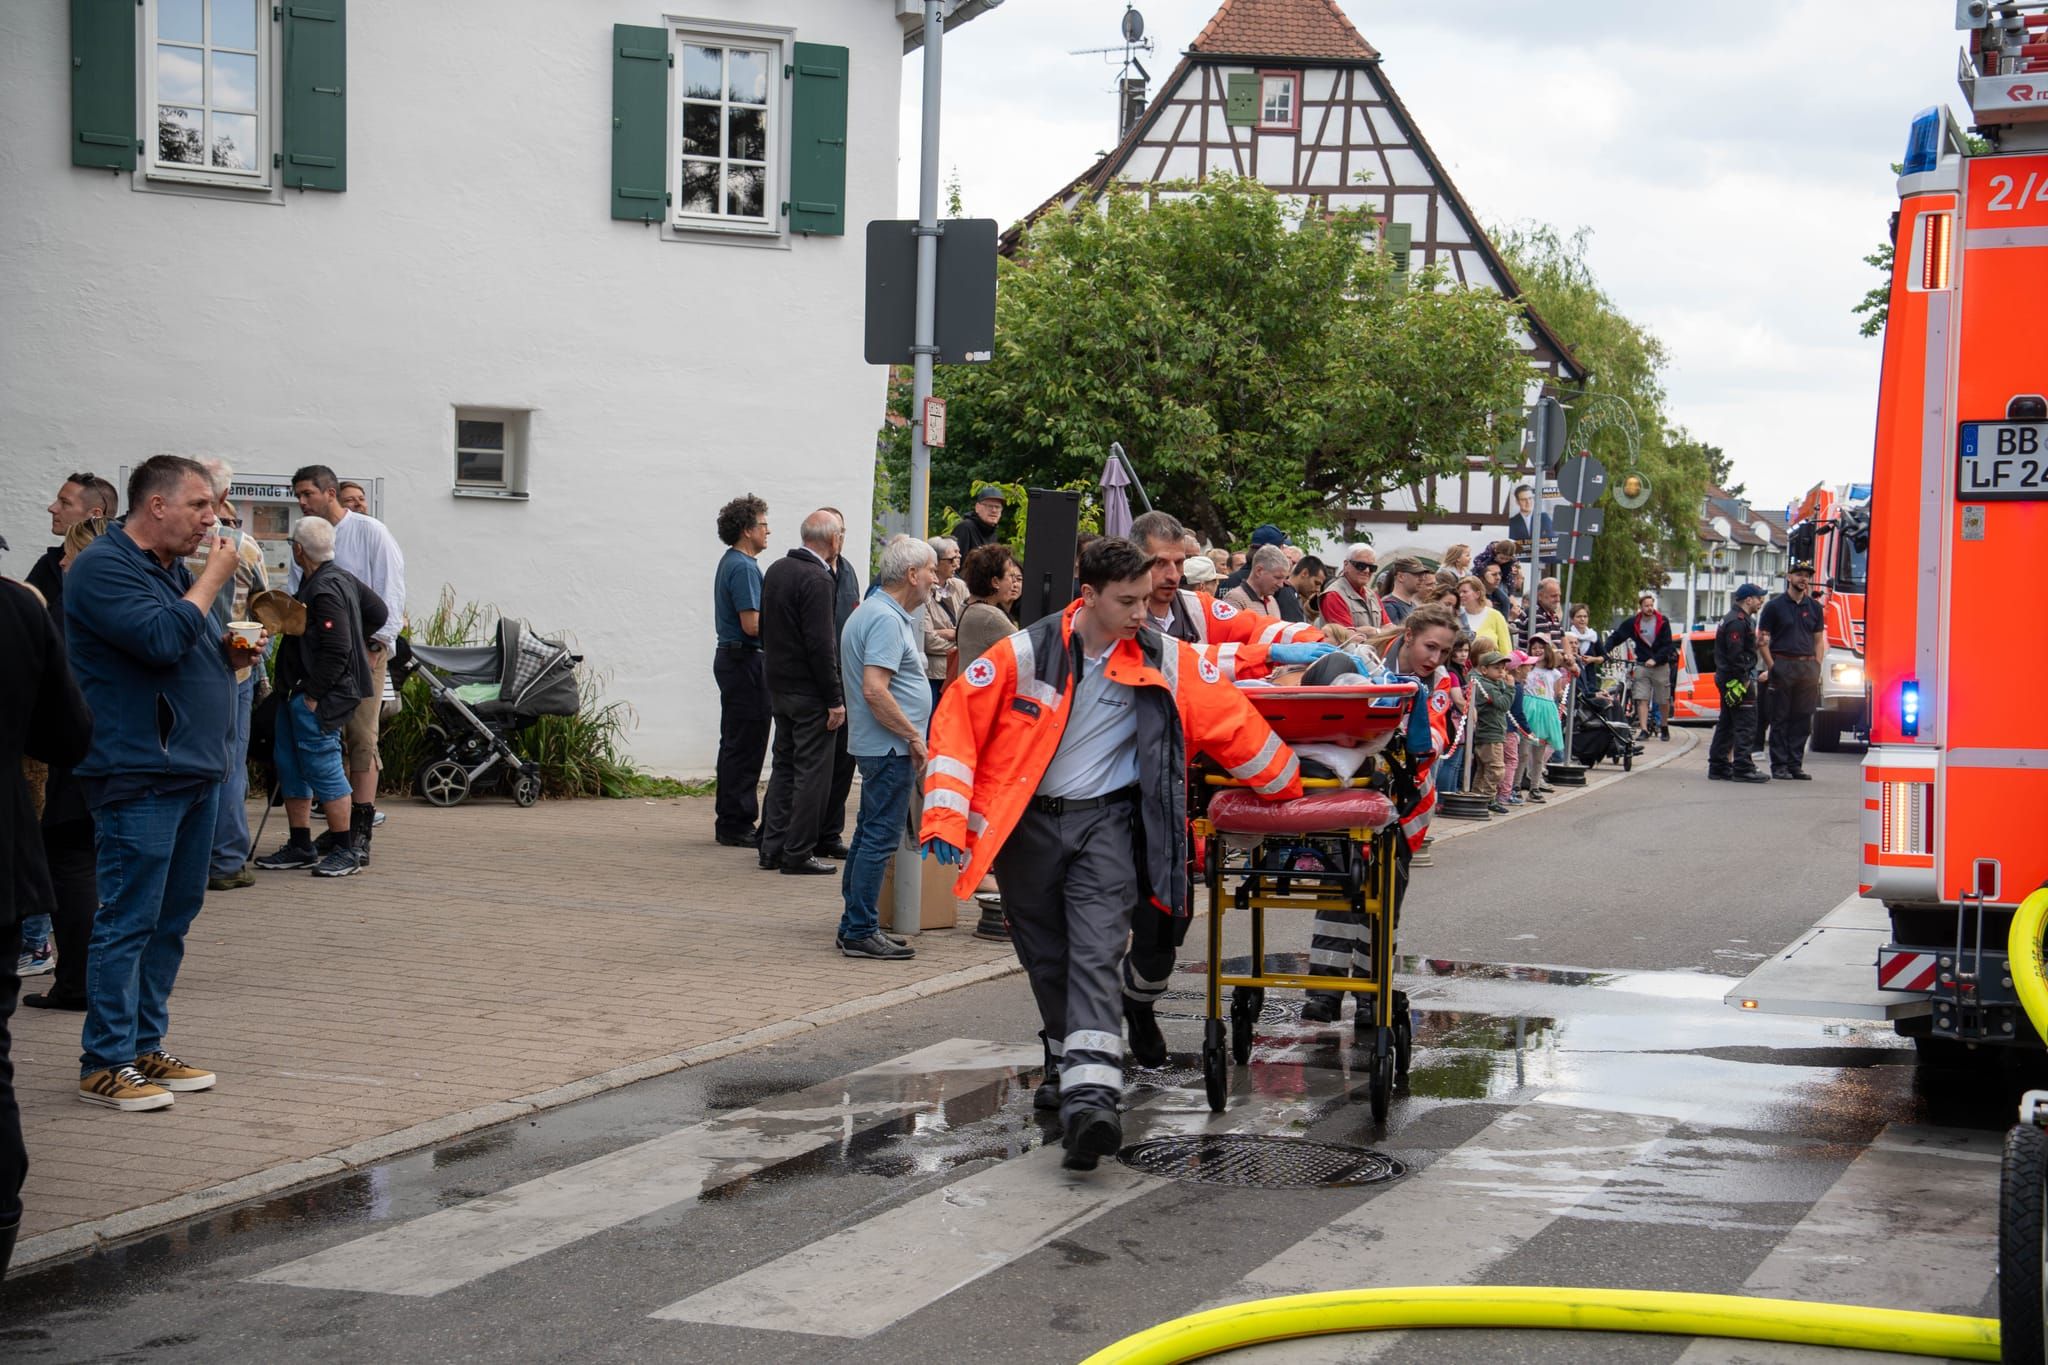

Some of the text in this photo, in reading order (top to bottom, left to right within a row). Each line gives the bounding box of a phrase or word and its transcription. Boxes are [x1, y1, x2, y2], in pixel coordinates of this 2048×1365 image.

[935, 11, 942, 23] 2
[1966, 444, 1974, 453] D
[1997, 427, 2038, 456] BB
[1971, 460, 2013, 488] LF
[229, 484, 282, 498] emeinde
